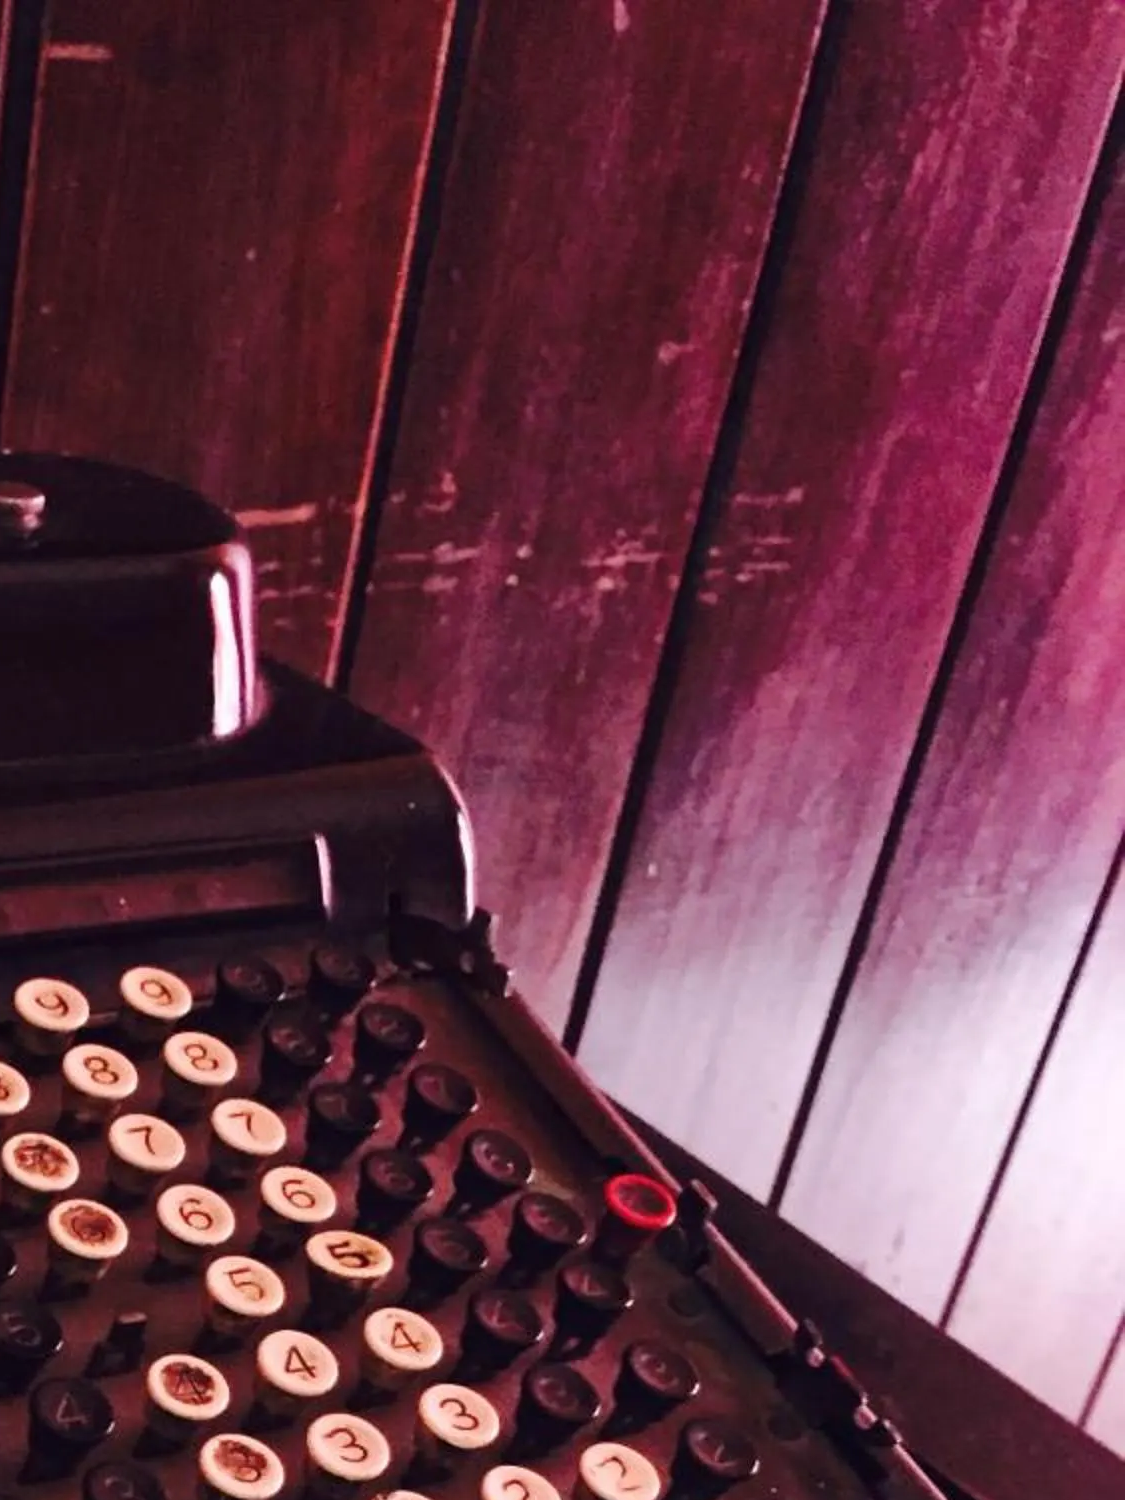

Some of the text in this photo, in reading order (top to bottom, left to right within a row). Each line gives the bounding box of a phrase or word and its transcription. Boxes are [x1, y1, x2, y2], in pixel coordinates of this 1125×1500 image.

[35, 991, 69, 1016] 9
[140, 978, 172, 1006] 9
[83, 1054, 119, 1086] 8
[183, 1042, 219, 1072] 8
[128, 1125, 155, 1153] 7
[230, 1111, 254, 1138] 7
[282, 1179, 315, 1209] 6
[179, 1198, 213, 1231] 6
[327, 1240, 369, 1269] 5
[226, 1267, 264, 1302] 5
[389, 1321, 421, 1354] 4
[285, 1345, 316, 1379] 4
[439, 1397, 479, 1431] 3
[325, 1427, 368, 1463] 3
